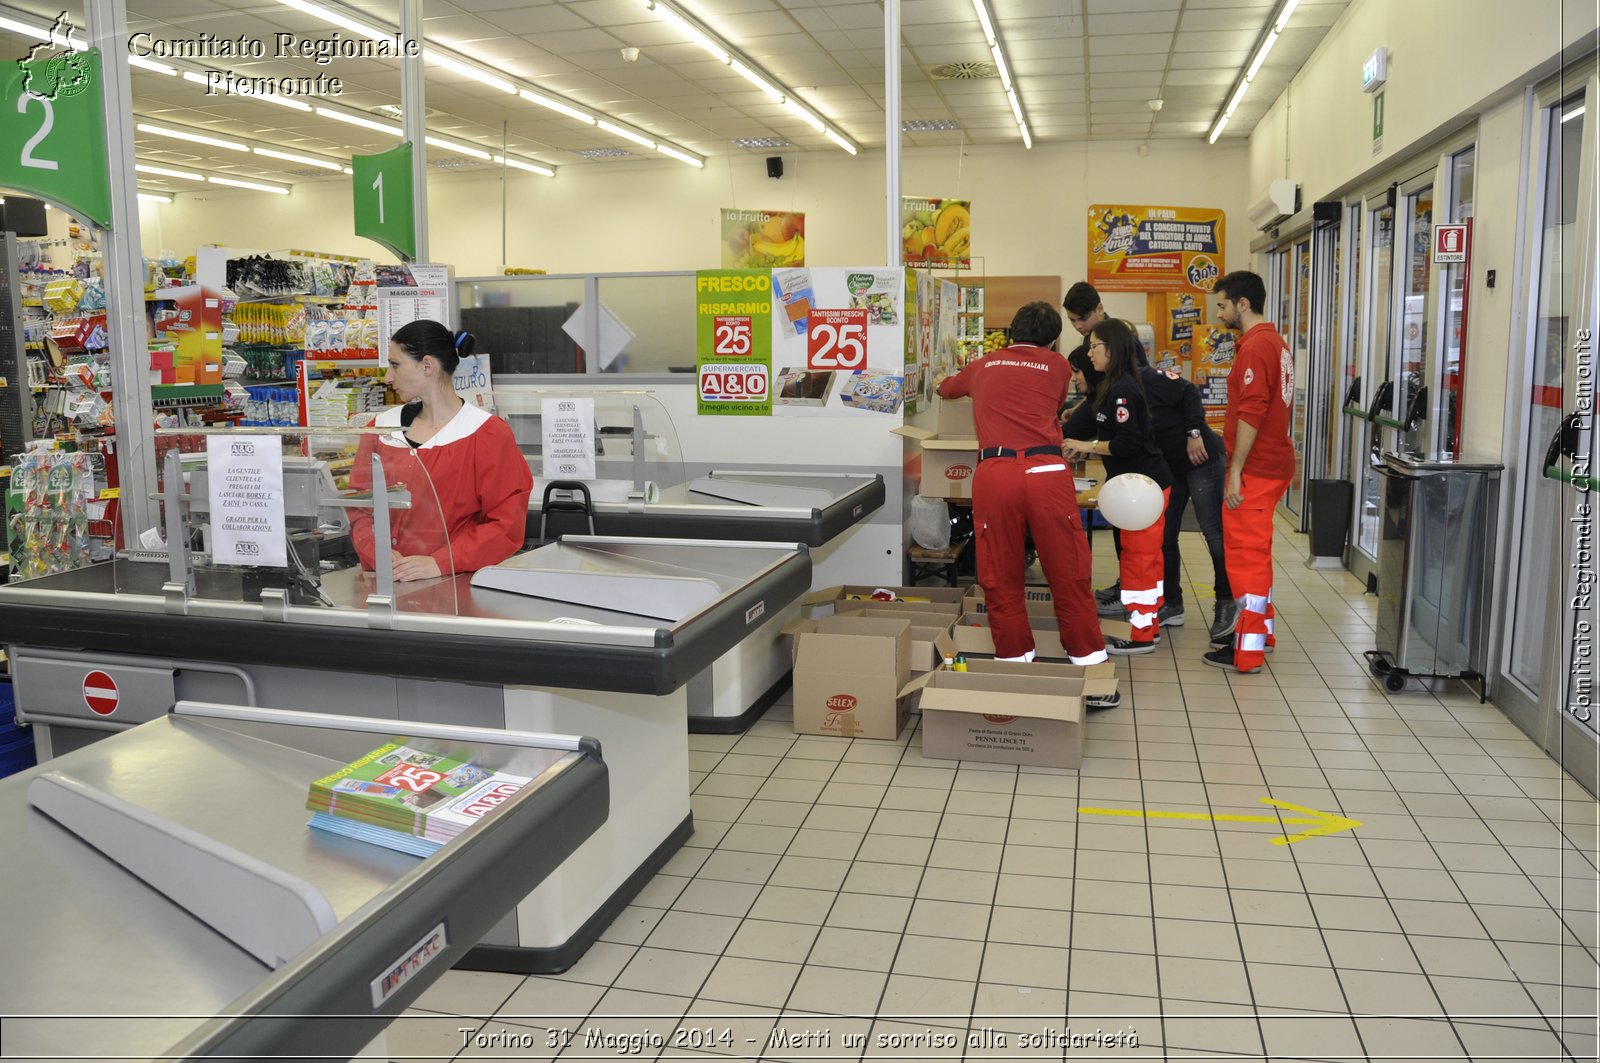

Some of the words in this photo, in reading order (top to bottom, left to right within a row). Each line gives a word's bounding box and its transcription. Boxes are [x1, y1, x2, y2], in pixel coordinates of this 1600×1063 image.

[17, 91, 59, 171] 2
[372, 171, 385, 224] 1
[738, 212, 771, 224] Frutta
[1153, 222, 1185, 233] CONCERTO
[1186, 224, 1212, 234] PRIVATO
[1153, 232, 1185, 242] VINCITORE
[1148, 240, 1183, 250] CATEGORIA
[1184, 242, 1203, 252] CANTO
[914, 260, 948, 269] profmato
[1188, 264, 1218, 286] Fanta
[697, 275, 770, 293] FRESCO
[699, 302, 771, 315] RISPARMIO
[984, 360, 1002, 368] CROCE
[1020, 362, 1049, 372] ITALIANA
[702, 374, 765, 394] A&O
[706, 404, 730, 412] meglio
[946, 466, 972, 478] SELEX
[828, 698, 854, 708] SELEX
